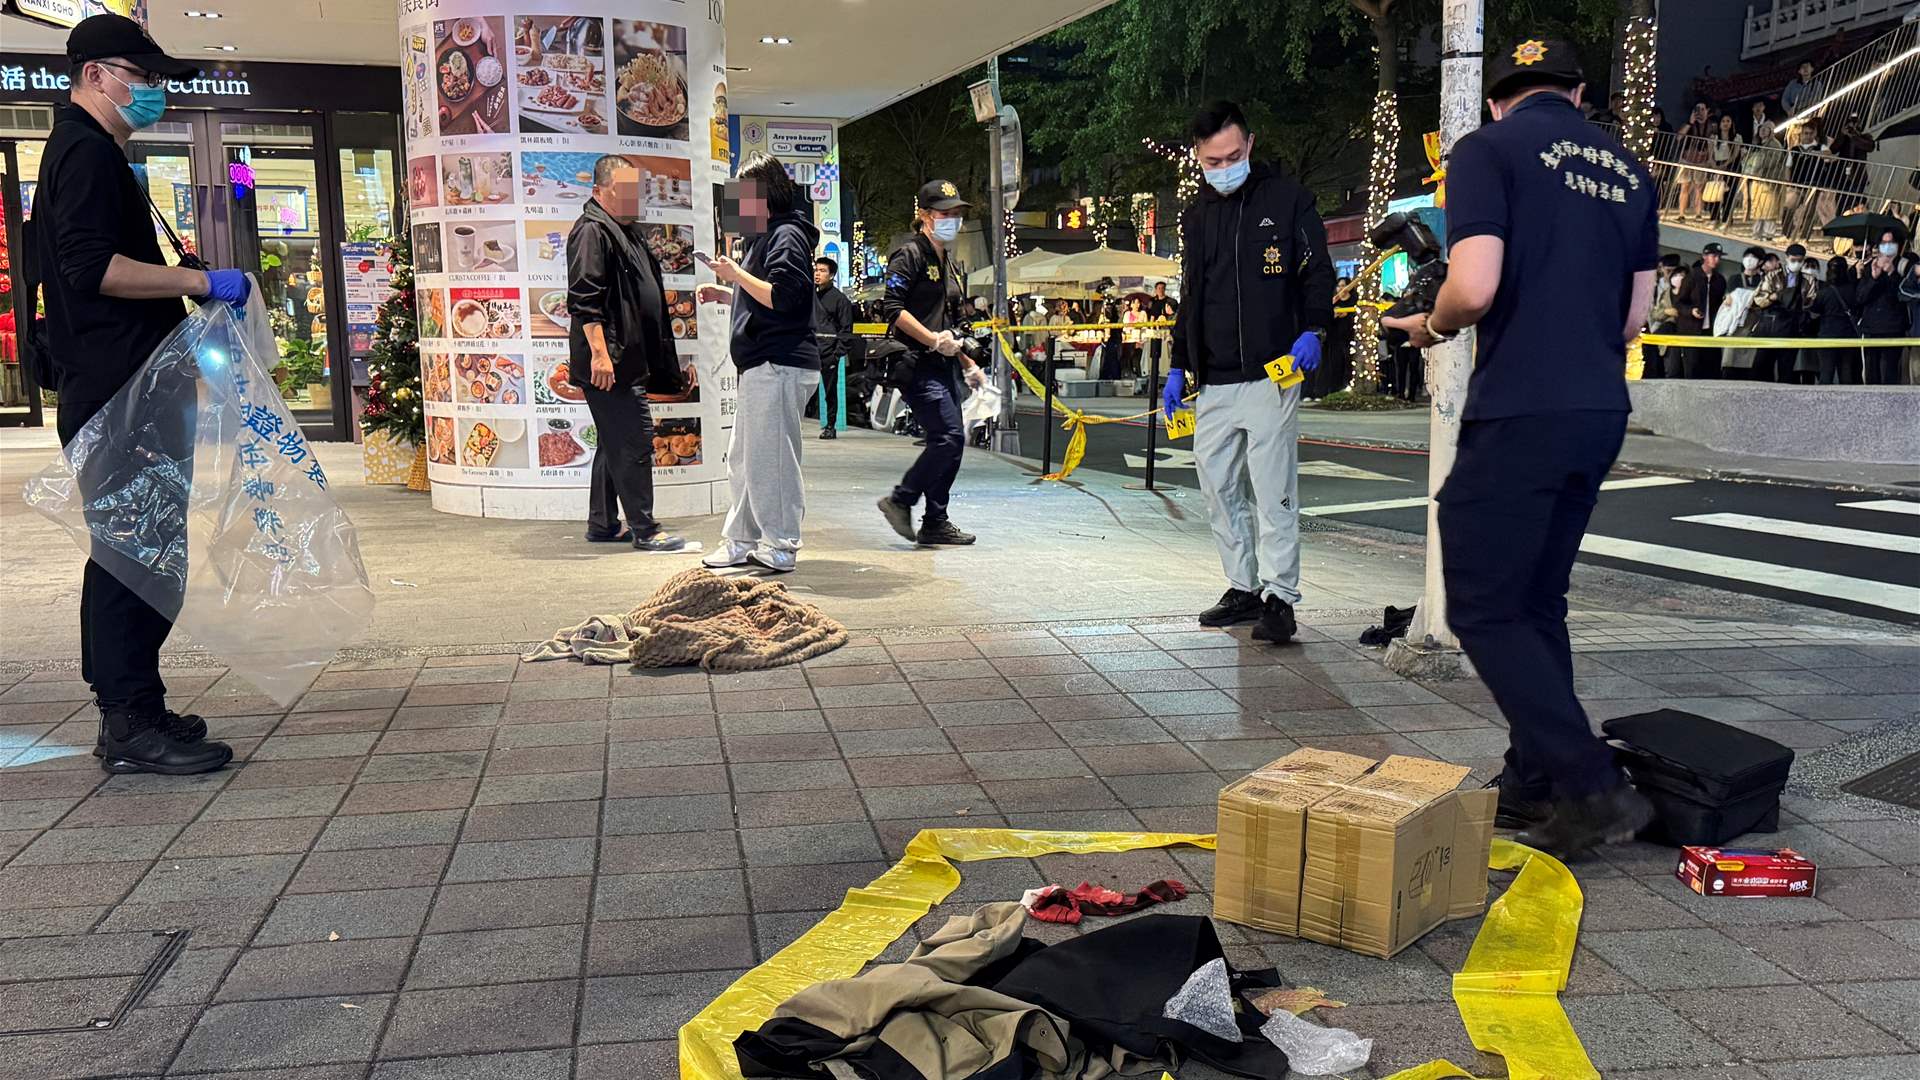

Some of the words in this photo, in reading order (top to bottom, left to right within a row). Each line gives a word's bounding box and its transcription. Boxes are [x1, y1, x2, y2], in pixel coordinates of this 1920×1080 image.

[52, 2, 73, 16] SOHO
[1, 65, 26, 91] 活
[30, 67, 69, 90] the
[165, 77, 251, 95] ectrum
[798, 134, 826, 142] hungry?
[1263, 265, 1283, 274] CID
[1274, 363, 1284, 376] 3
[1177, 418, 1186, 429] 2
[1789, 879, 1809, 892] NBR
